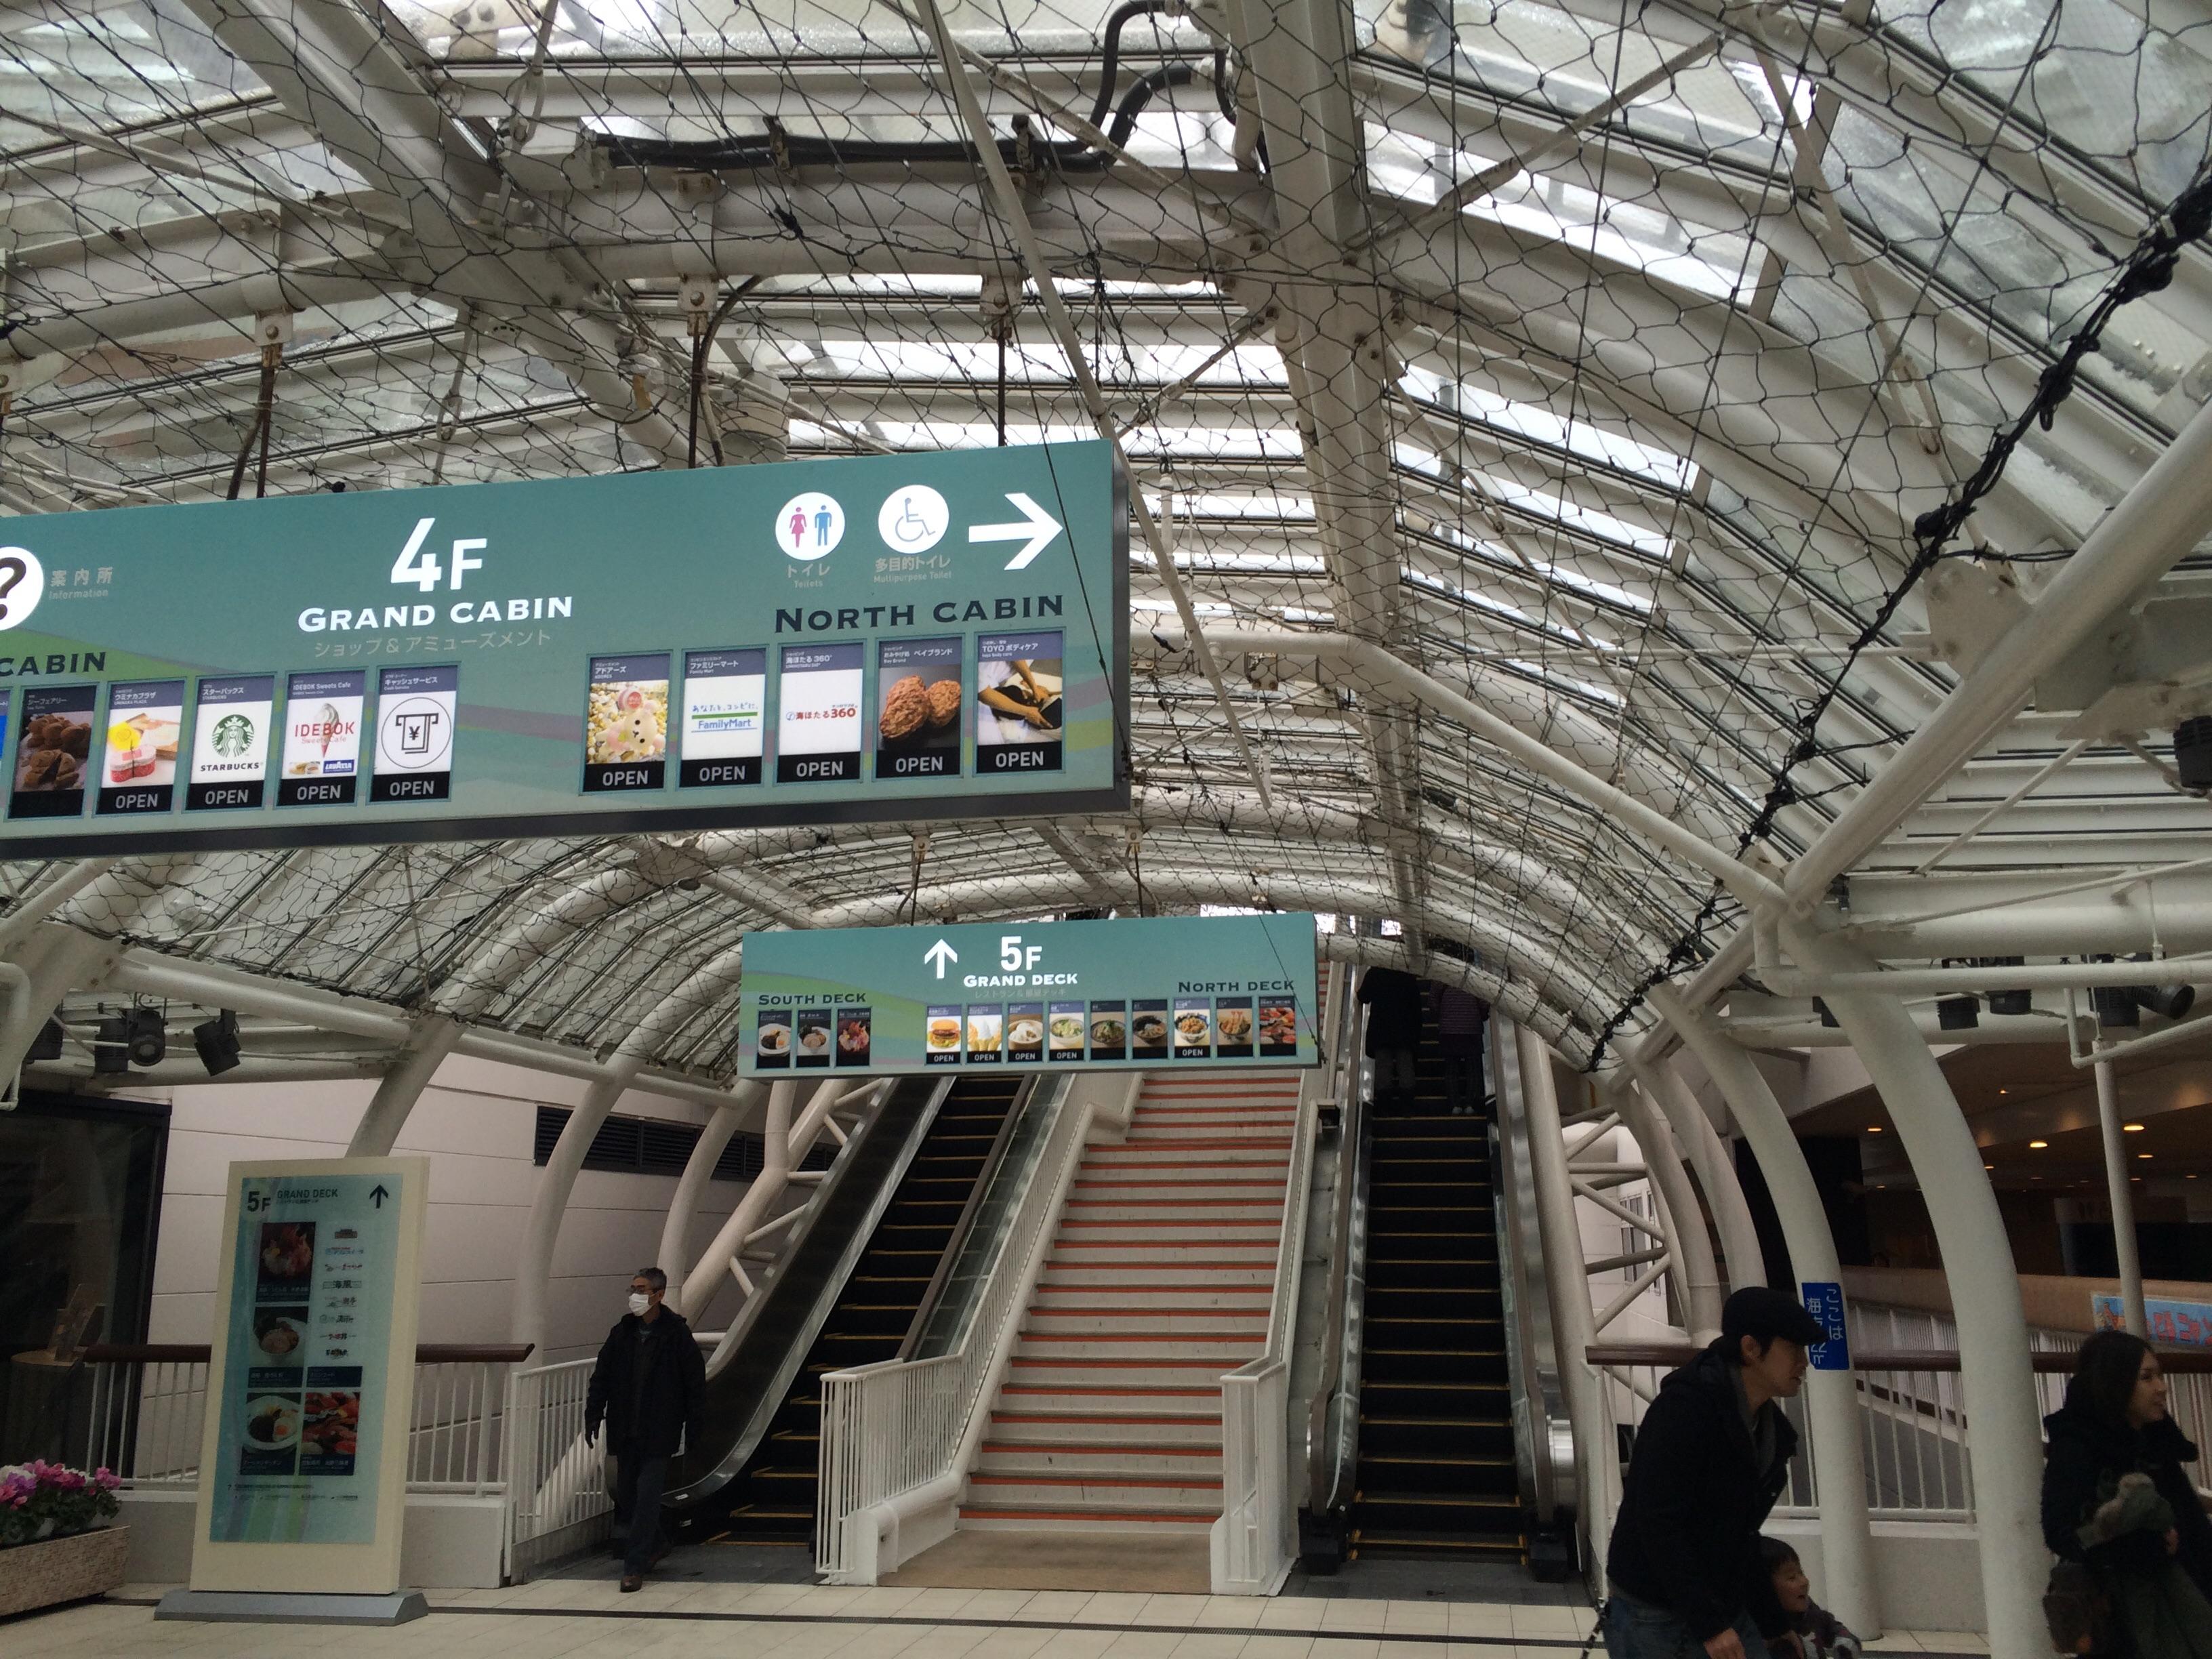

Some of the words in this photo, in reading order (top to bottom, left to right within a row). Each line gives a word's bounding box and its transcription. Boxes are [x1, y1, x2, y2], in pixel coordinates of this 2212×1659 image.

[390, 517, 487, 592] 4F
[787, 562, 830, 578] トイレ
[874, 555, 951, 572] 多目的トイレ
[50, 566, 114, 587] 案内所
[794, 579, 823, 588] Toilets
[873, 573, 928, 583] Multipurpose
[930, 571, 952, 580] Toilet
[49, 588, 109, 600] Information
[298, 604, 436, 633] GRAND
[449, 596, 573, 623] CABIN
[775, 605, 916, 634] NORTH
[933, 595, 1063, 623] CABIN
[981, 644, 1005, 653] TOYO
[0, 651, 106, 677] CABIN
[690, 660, 739, 670] ファミリーマート
[384, 676, 438, 686] キャッシュサービス
[202, 687, 245, 696] スターバックス
[294, 721, 355, 737] IDEBOK
[697, 718, 752, 730] FamilyMart
[200, 762, 260, 772] STARBUCKS
[895, 756, 943, 773] OPEN
[996, 751, 1044, 768] OPEN
[699, 765, 746, 781] OPEN
[796, 760, 844, 777] OPEN
[602, 770, 649, 786] OPEN
[297, 785, 341, 800] OPEN
[389, 780, 434, 796] OPEN
[115, 793, 158, 809] OPEN
[205, 789, 249, 804] OPEN
[1000, 935, 1043, 972] 5F
[963, 975, 1026, 987] GRAND
[1031, 973, 1078, 985] DECK
[1179, 981, 1240, 993] NORTH
[1247, 980, 1294, 991] DECK
[758, 994, 815, 1006] SOUTH
[822, 992, 867, 1004] DECK
[933, 1054, 954, 1063] OPEN
[974, 1054, 995, 1062] OPEN
[1015, 1052, 1036, 1061] OPEN
[1056, 1051, 1078, 1060] OPEN
[1182, 1048, 1204, 1057] OPEN
[247, 1191, 271, 1212] 5F
[276, 1189, 310, 1200] GRAND
[312, 1188, 338, 1199] DECK
[1826, 1288, 1844, 1340] ここは
